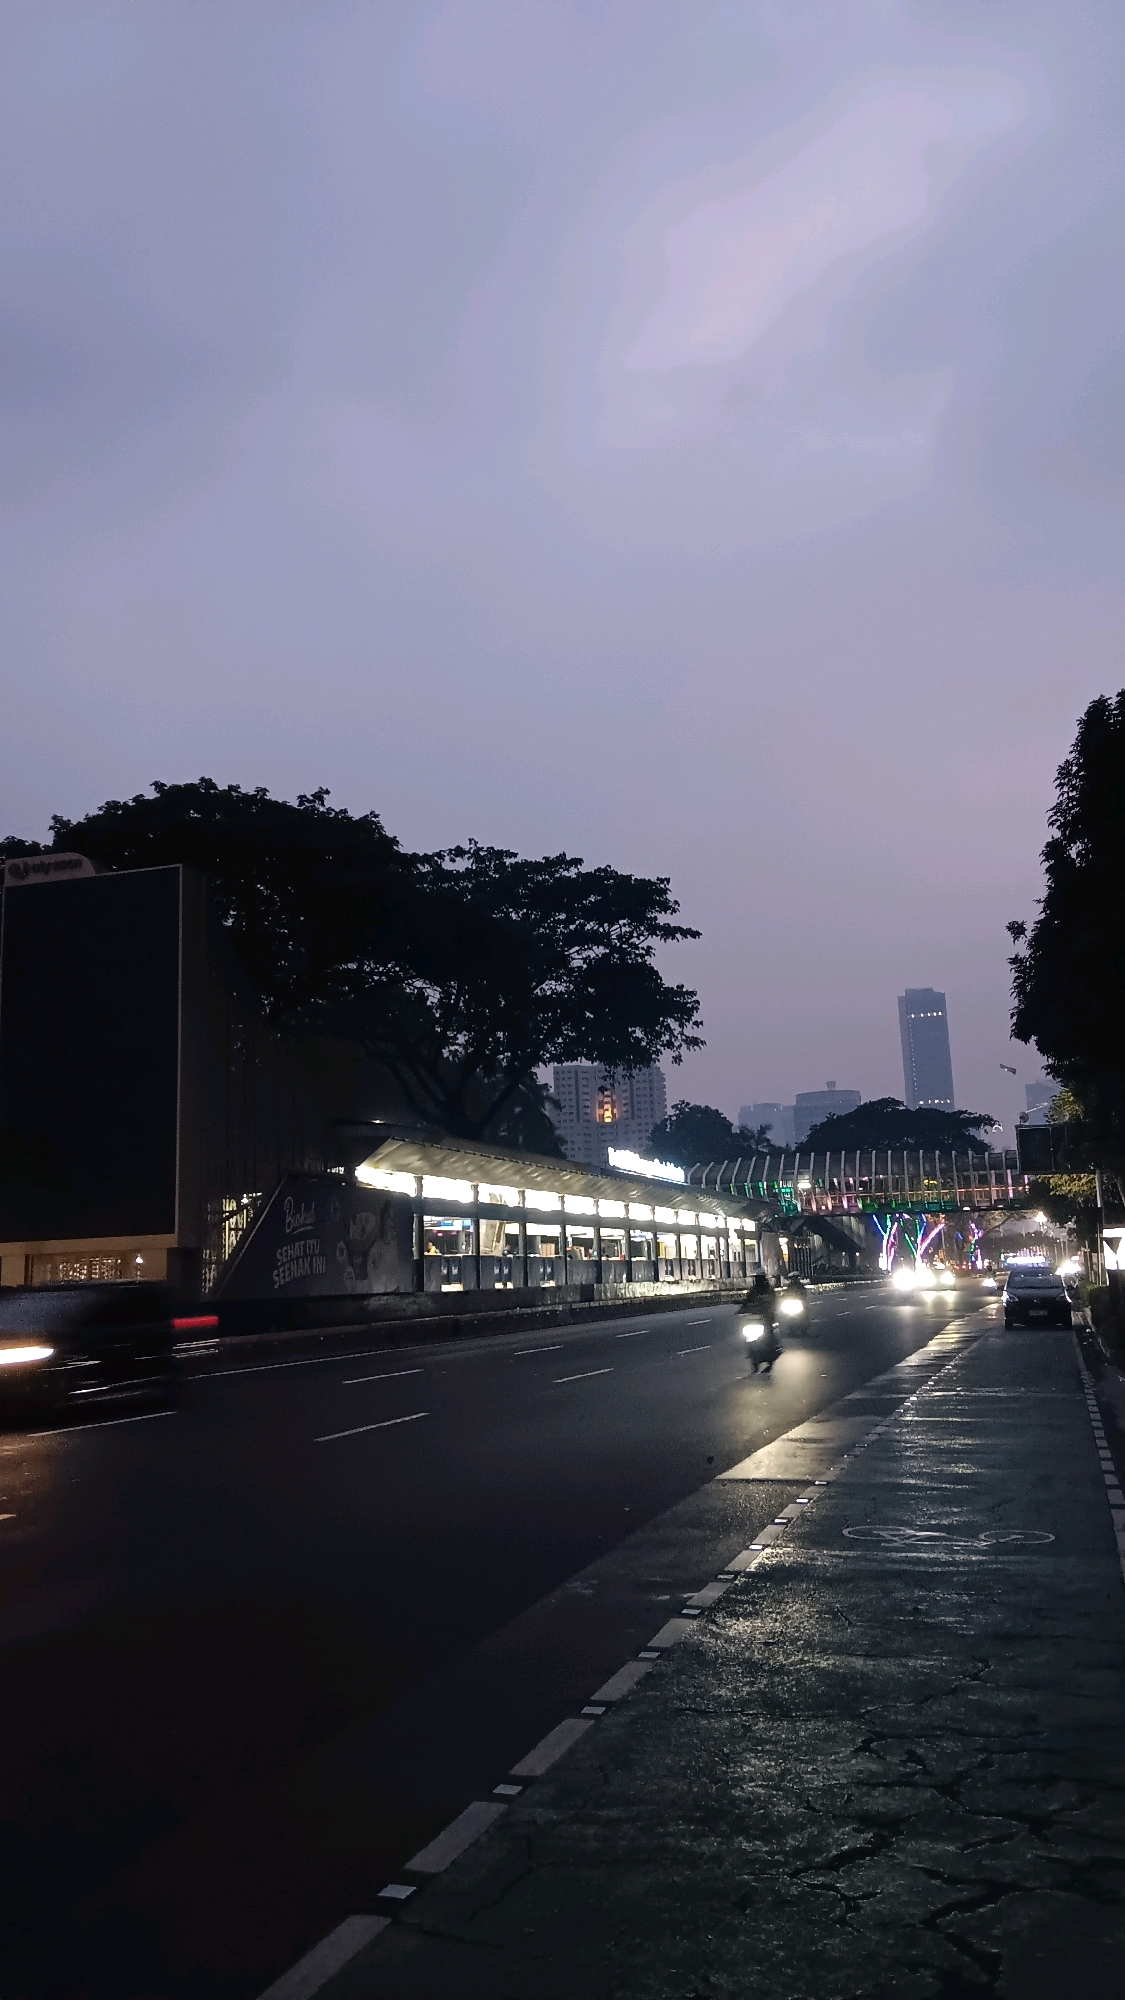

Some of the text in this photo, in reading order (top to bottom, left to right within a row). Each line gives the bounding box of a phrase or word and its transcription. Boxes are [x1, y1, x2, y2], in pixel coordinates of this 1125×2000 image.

[277, 1238, 320, 1266] SEHAT ITU
[273, 1256, 326, 1289] SEENAK INI
